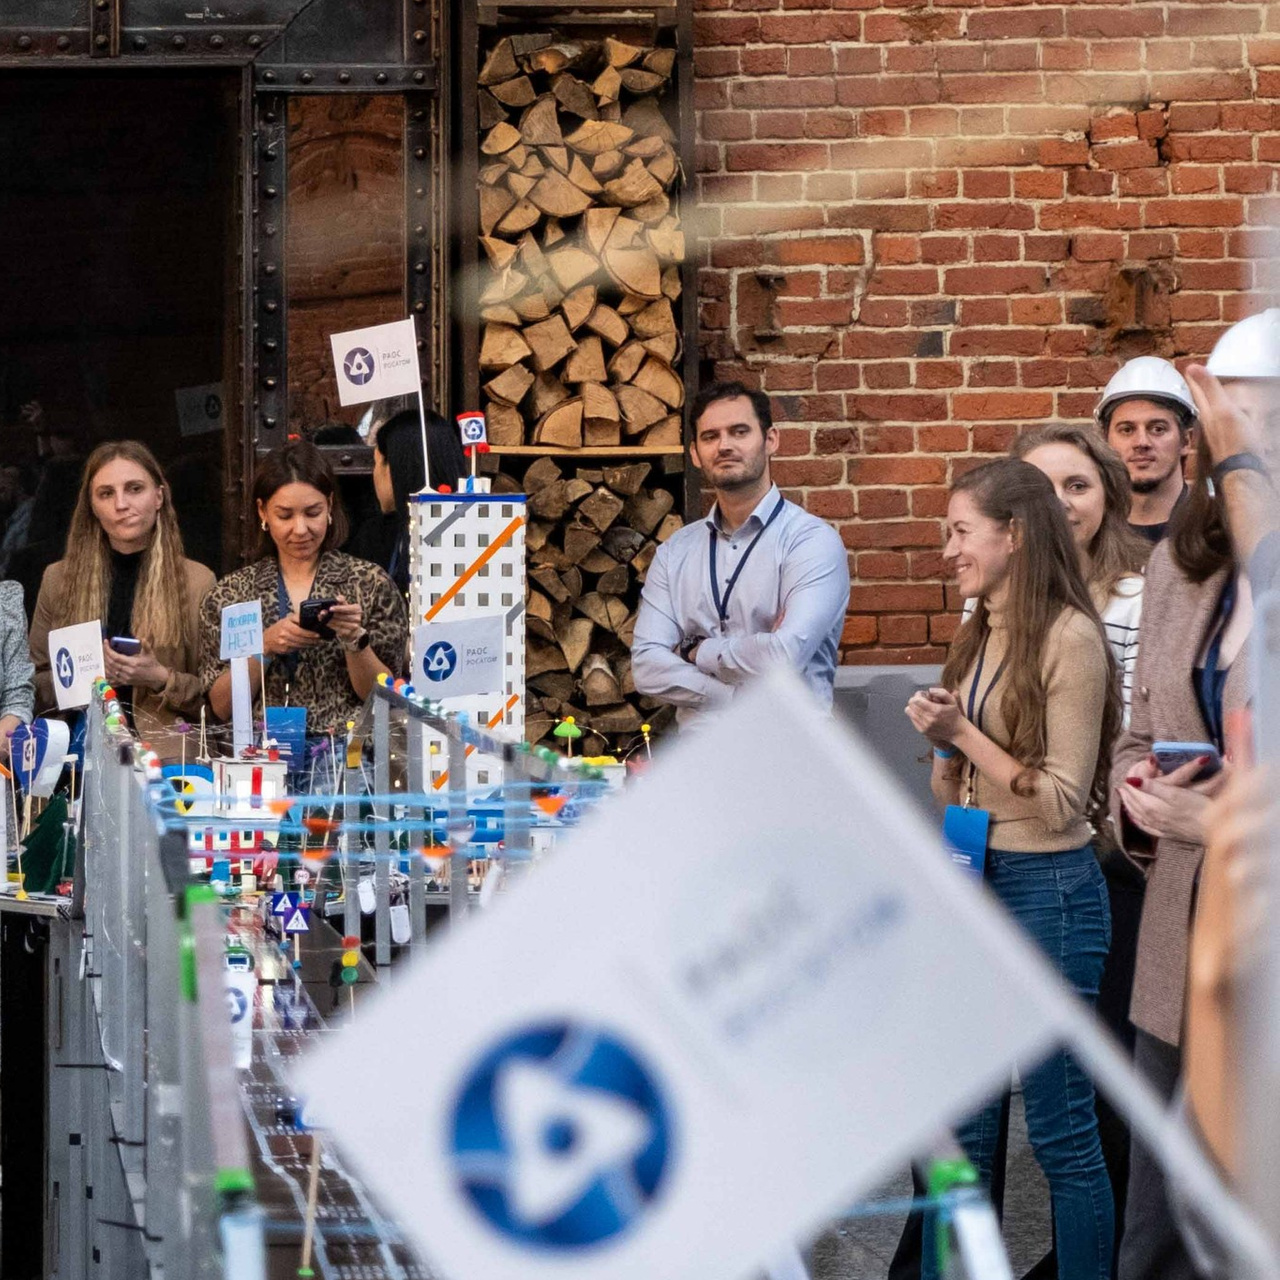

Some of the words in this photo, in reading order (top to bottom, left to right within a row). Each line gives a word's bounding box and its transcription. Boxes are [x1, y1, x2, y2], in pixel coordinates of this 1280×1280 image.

[382, 349, 402, 360] РАОС
[383, 359, 411, 370] РОСАТОМ
[466, 646, 488, 657] РАОС
[466, 656, 498, 666] РОСАТОМ
